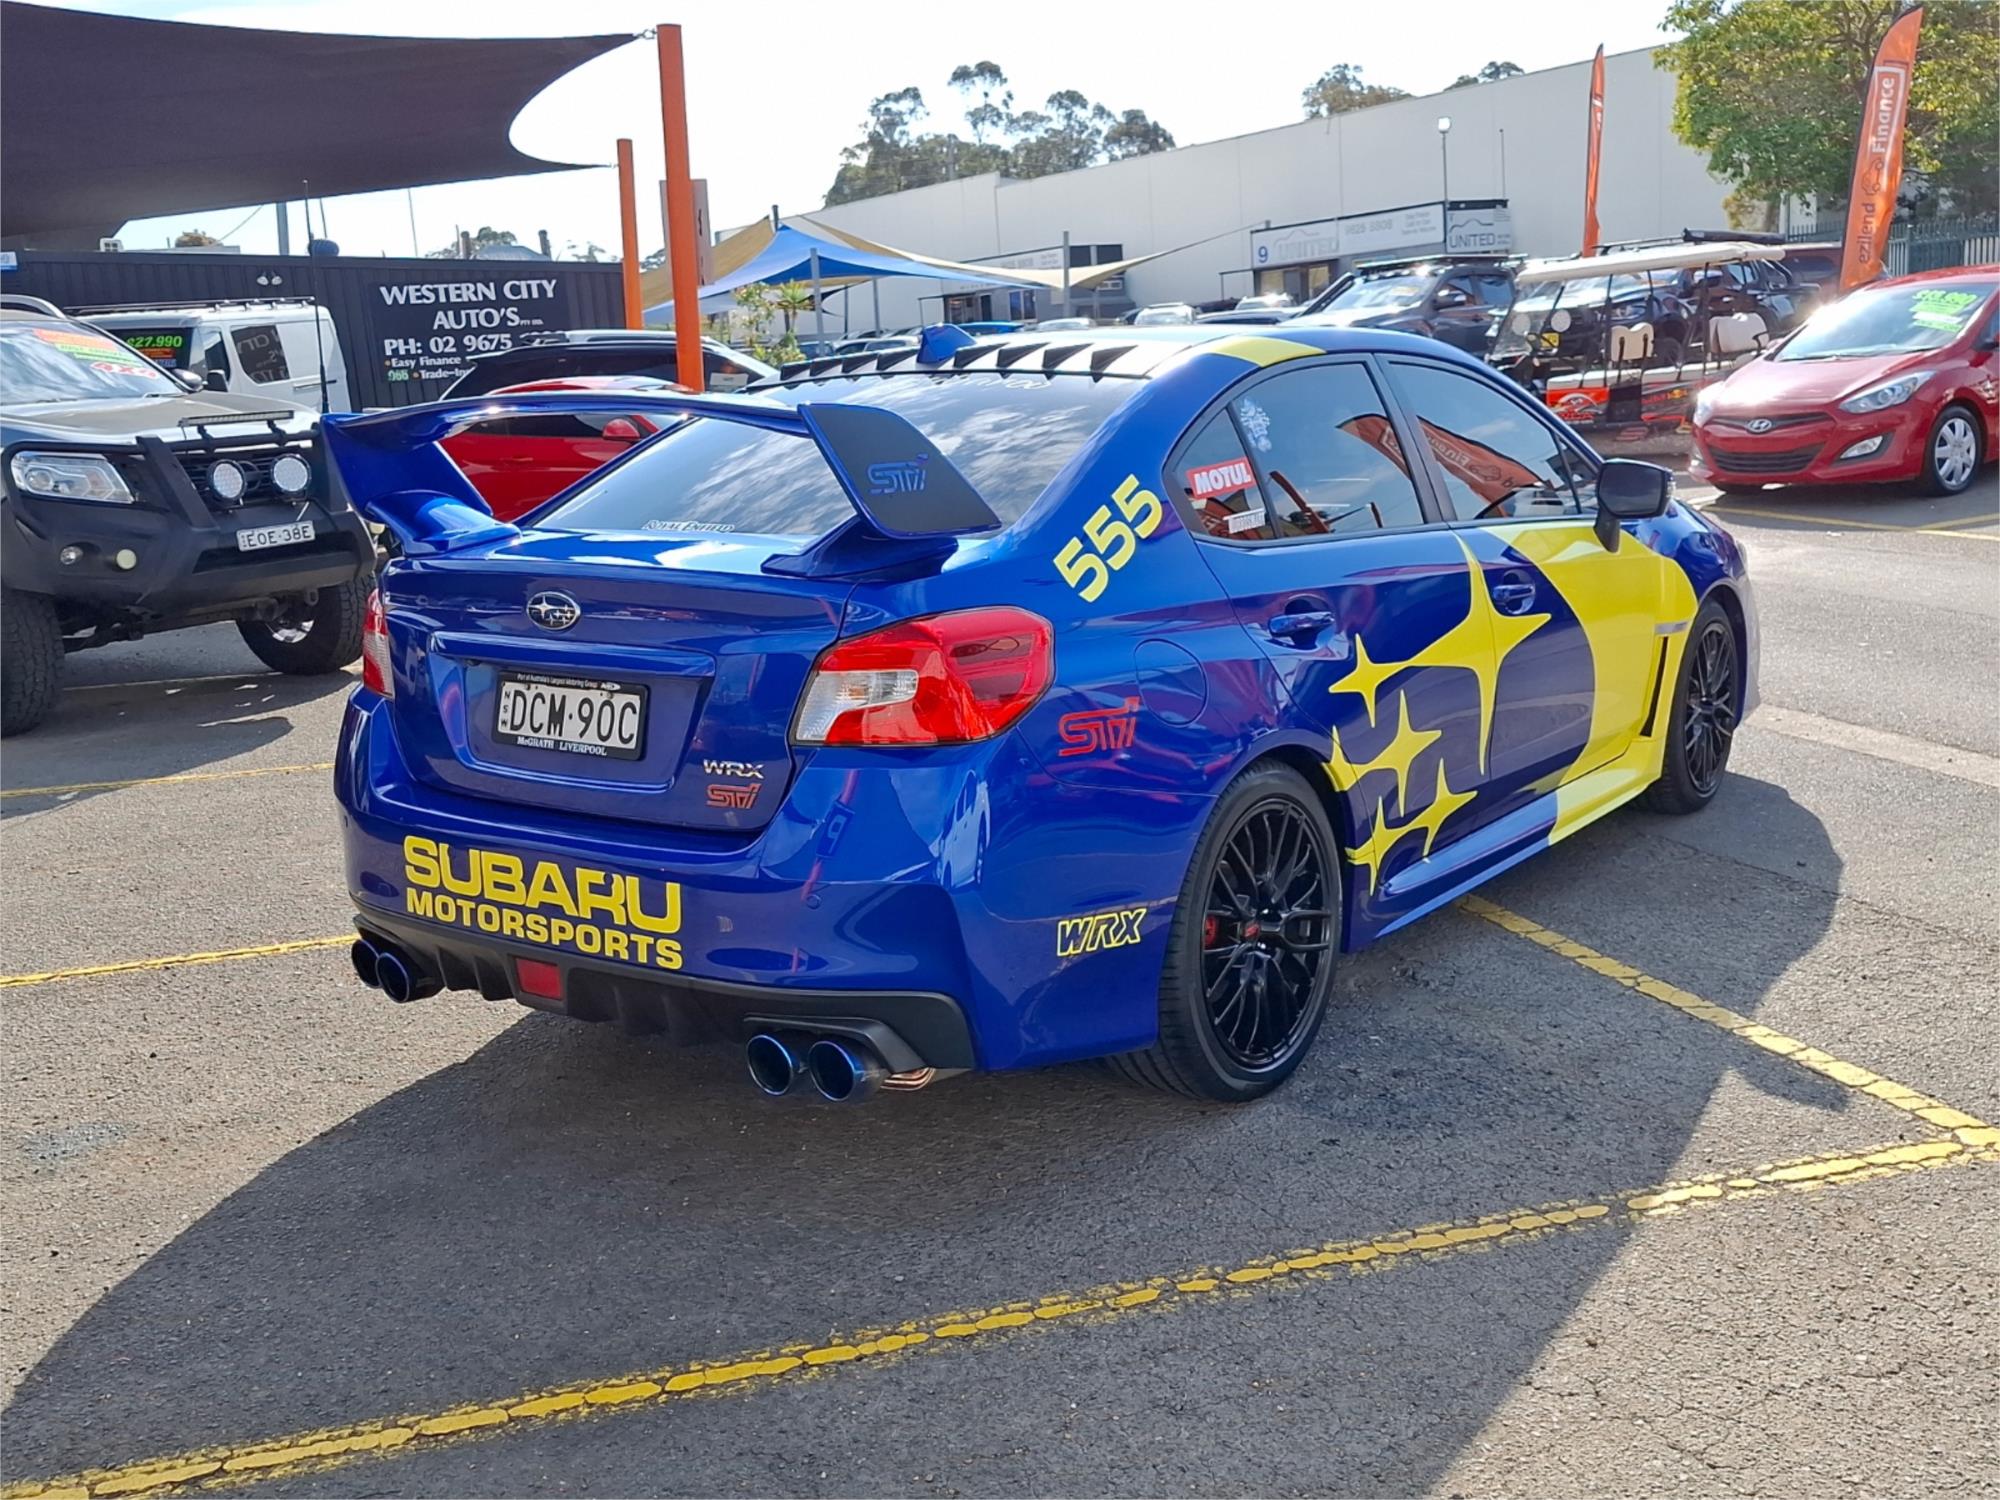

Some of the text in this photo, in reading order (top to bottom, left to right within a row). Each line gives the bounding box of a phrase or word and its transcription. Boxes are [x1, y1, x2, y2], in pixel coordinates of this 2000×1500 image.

[1872, 77, 1895, 154] Finance
[1449, 233, 1496, 248] UNITED
[1858, 203, 1876, 263] ezilend
[1258, 246, 1268, 263] 9
[380, 279, 557, 305] WESTERN CITY
[433, 307, 520, 330] AUTO'S
[384, 333, 512, 355] PH: 02 9675
[391, 355, 461, 369] Easy Finance
[1193, 463, 1252, 495] MOTUL
[641, 519, 681, 531] ROYAL
[1052, 473, 1163, 603] 555
[517, 736, 607, 756] McGRATH LIVERPOOL
[703, 759, 764, 779] WRX
[403, 835, 681, 934] SUBARU
[406, 887, 683, 970] MOTORSPORTS
[1057, 908, 1147, 956] WRX
